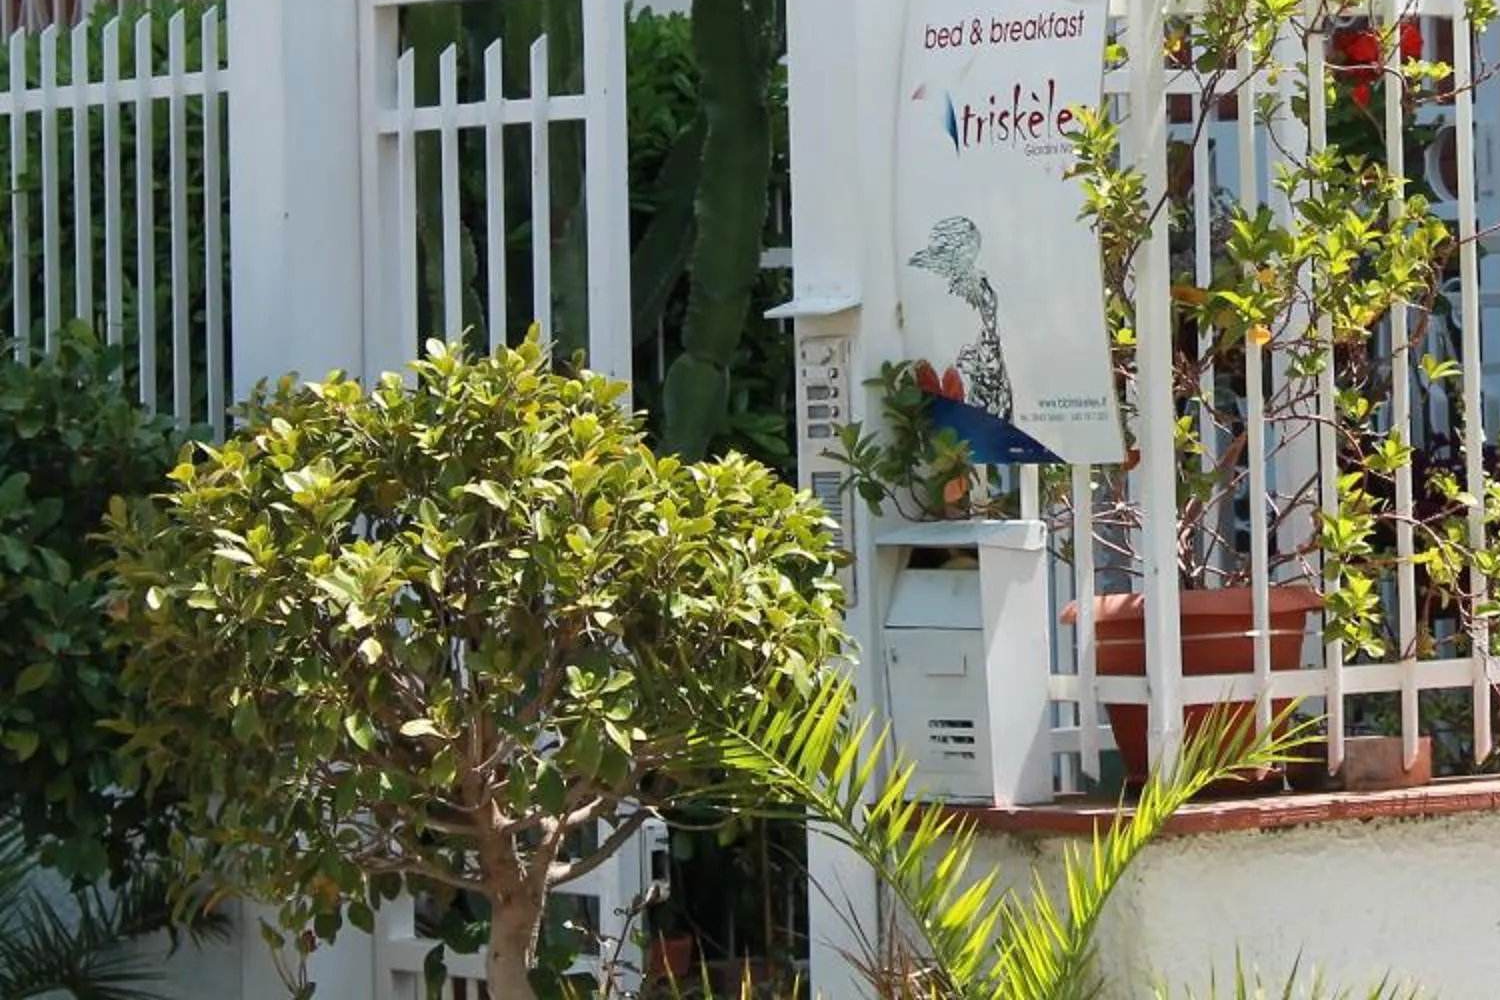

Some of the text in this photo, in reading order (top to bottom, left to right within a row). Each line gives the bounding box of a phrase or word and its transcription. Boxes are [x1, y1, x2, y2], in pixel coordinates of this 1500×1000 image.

[924, 10, 1085, 49] bed & breakfast
[960, 79, 1087, 148] triskèle
